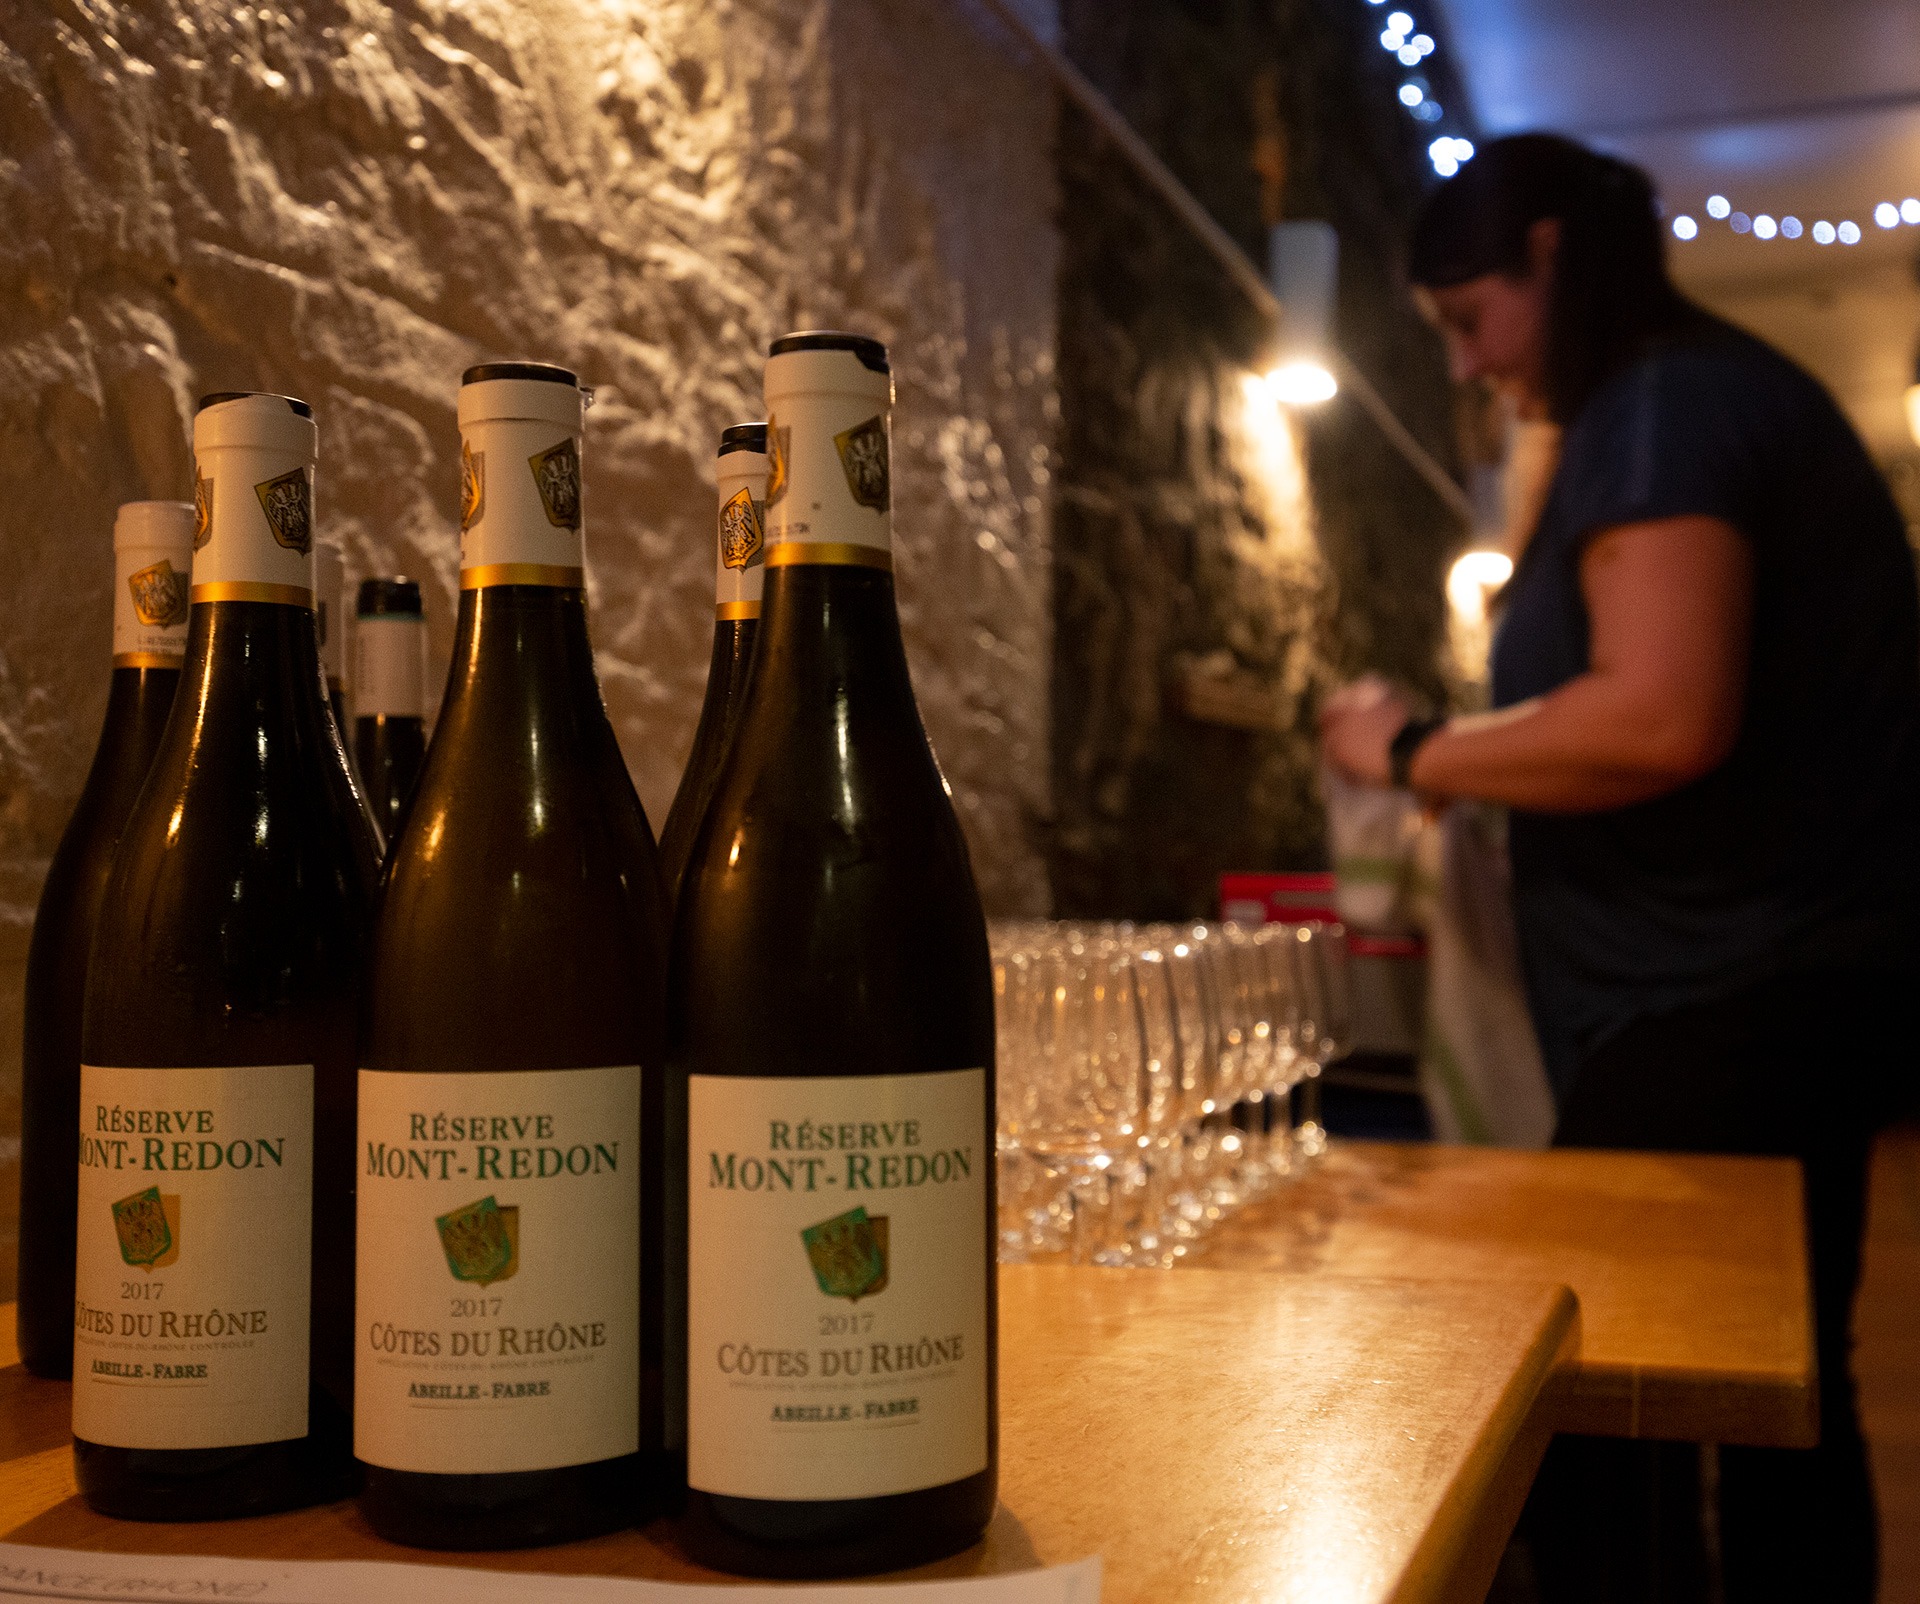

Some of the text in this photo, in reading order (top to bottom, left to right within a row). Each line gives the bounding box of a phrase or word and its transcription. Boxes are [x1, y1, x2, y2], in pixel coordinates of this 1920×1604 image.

[96, 1105, 214, 1133] RÉSERVE
[409, 1112, 555, 1141] RÉSERVE
[770, 1119, 921, 1150] RÉSERVE
[366, 1142, 619, 1180] MONT-REDON
[709, 1148, 971, 1191] MONT-REDON
[121, 1282, 163, 1300] 2017
[121, 1313, 153, 1337] DU
[160, 1308, 268, 1338] RHÔNE
[451, 1299, 503, 1318] 2017
[818, 1312, 875, 1335] 2017
[370, 1322, 606, 1357] CÔTES DU RHÔNE
[717, 1335, 964, 1377] CÔTES DU RHÔNE
